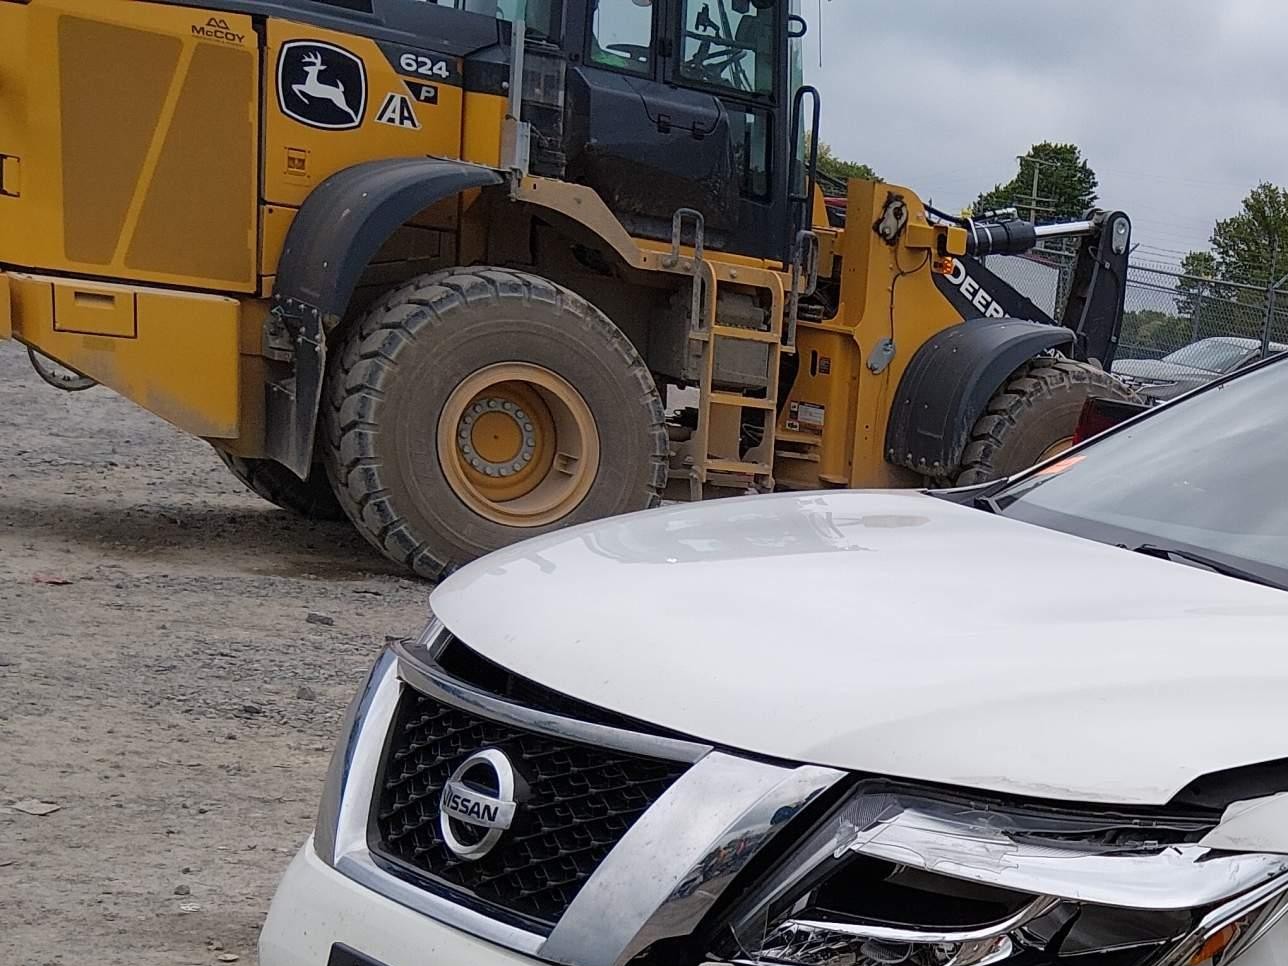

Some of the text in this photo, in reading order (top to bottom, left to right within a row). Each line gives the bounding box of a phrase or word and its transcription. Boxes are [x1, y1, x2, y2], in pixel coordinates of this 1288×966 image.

[191, 25, 245, 43] McCOY
[400, 53, 450, 78] 624
[420, 86, 435, 101] P
[944, 257, 1012, 319] DEER
[443, 783, 499, 822] NISSAN
